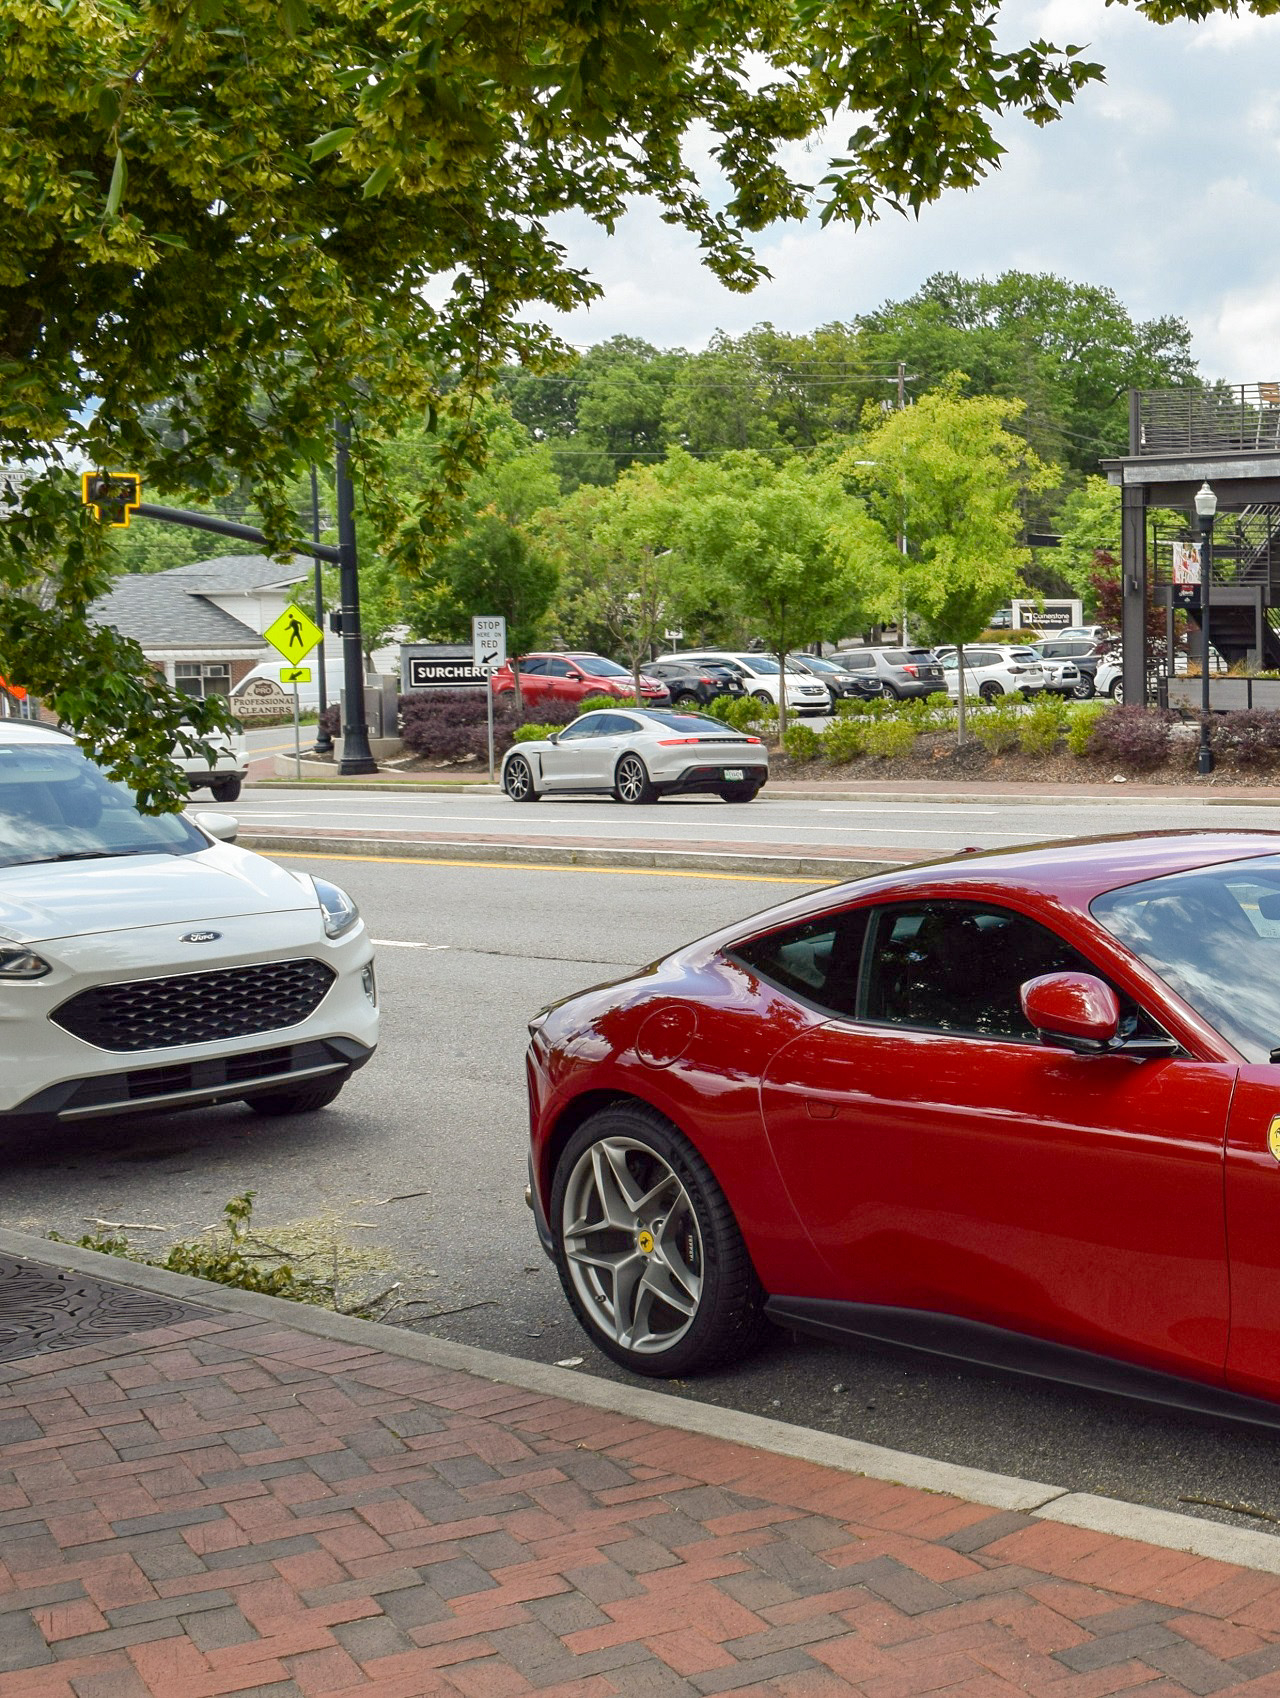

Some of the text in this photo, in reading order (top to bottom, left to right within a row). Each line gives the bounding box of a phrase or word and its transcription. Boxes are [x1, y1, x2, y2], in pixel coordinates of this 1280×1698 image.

[478, 622, 500, 630] STOP
[481, 640, 498, 648] RED
[234, 698, 295, 706] PROFESSIONAL
[238, 706, 292, 714] CLEANERS
[190, 933, 215, 942] Ford
